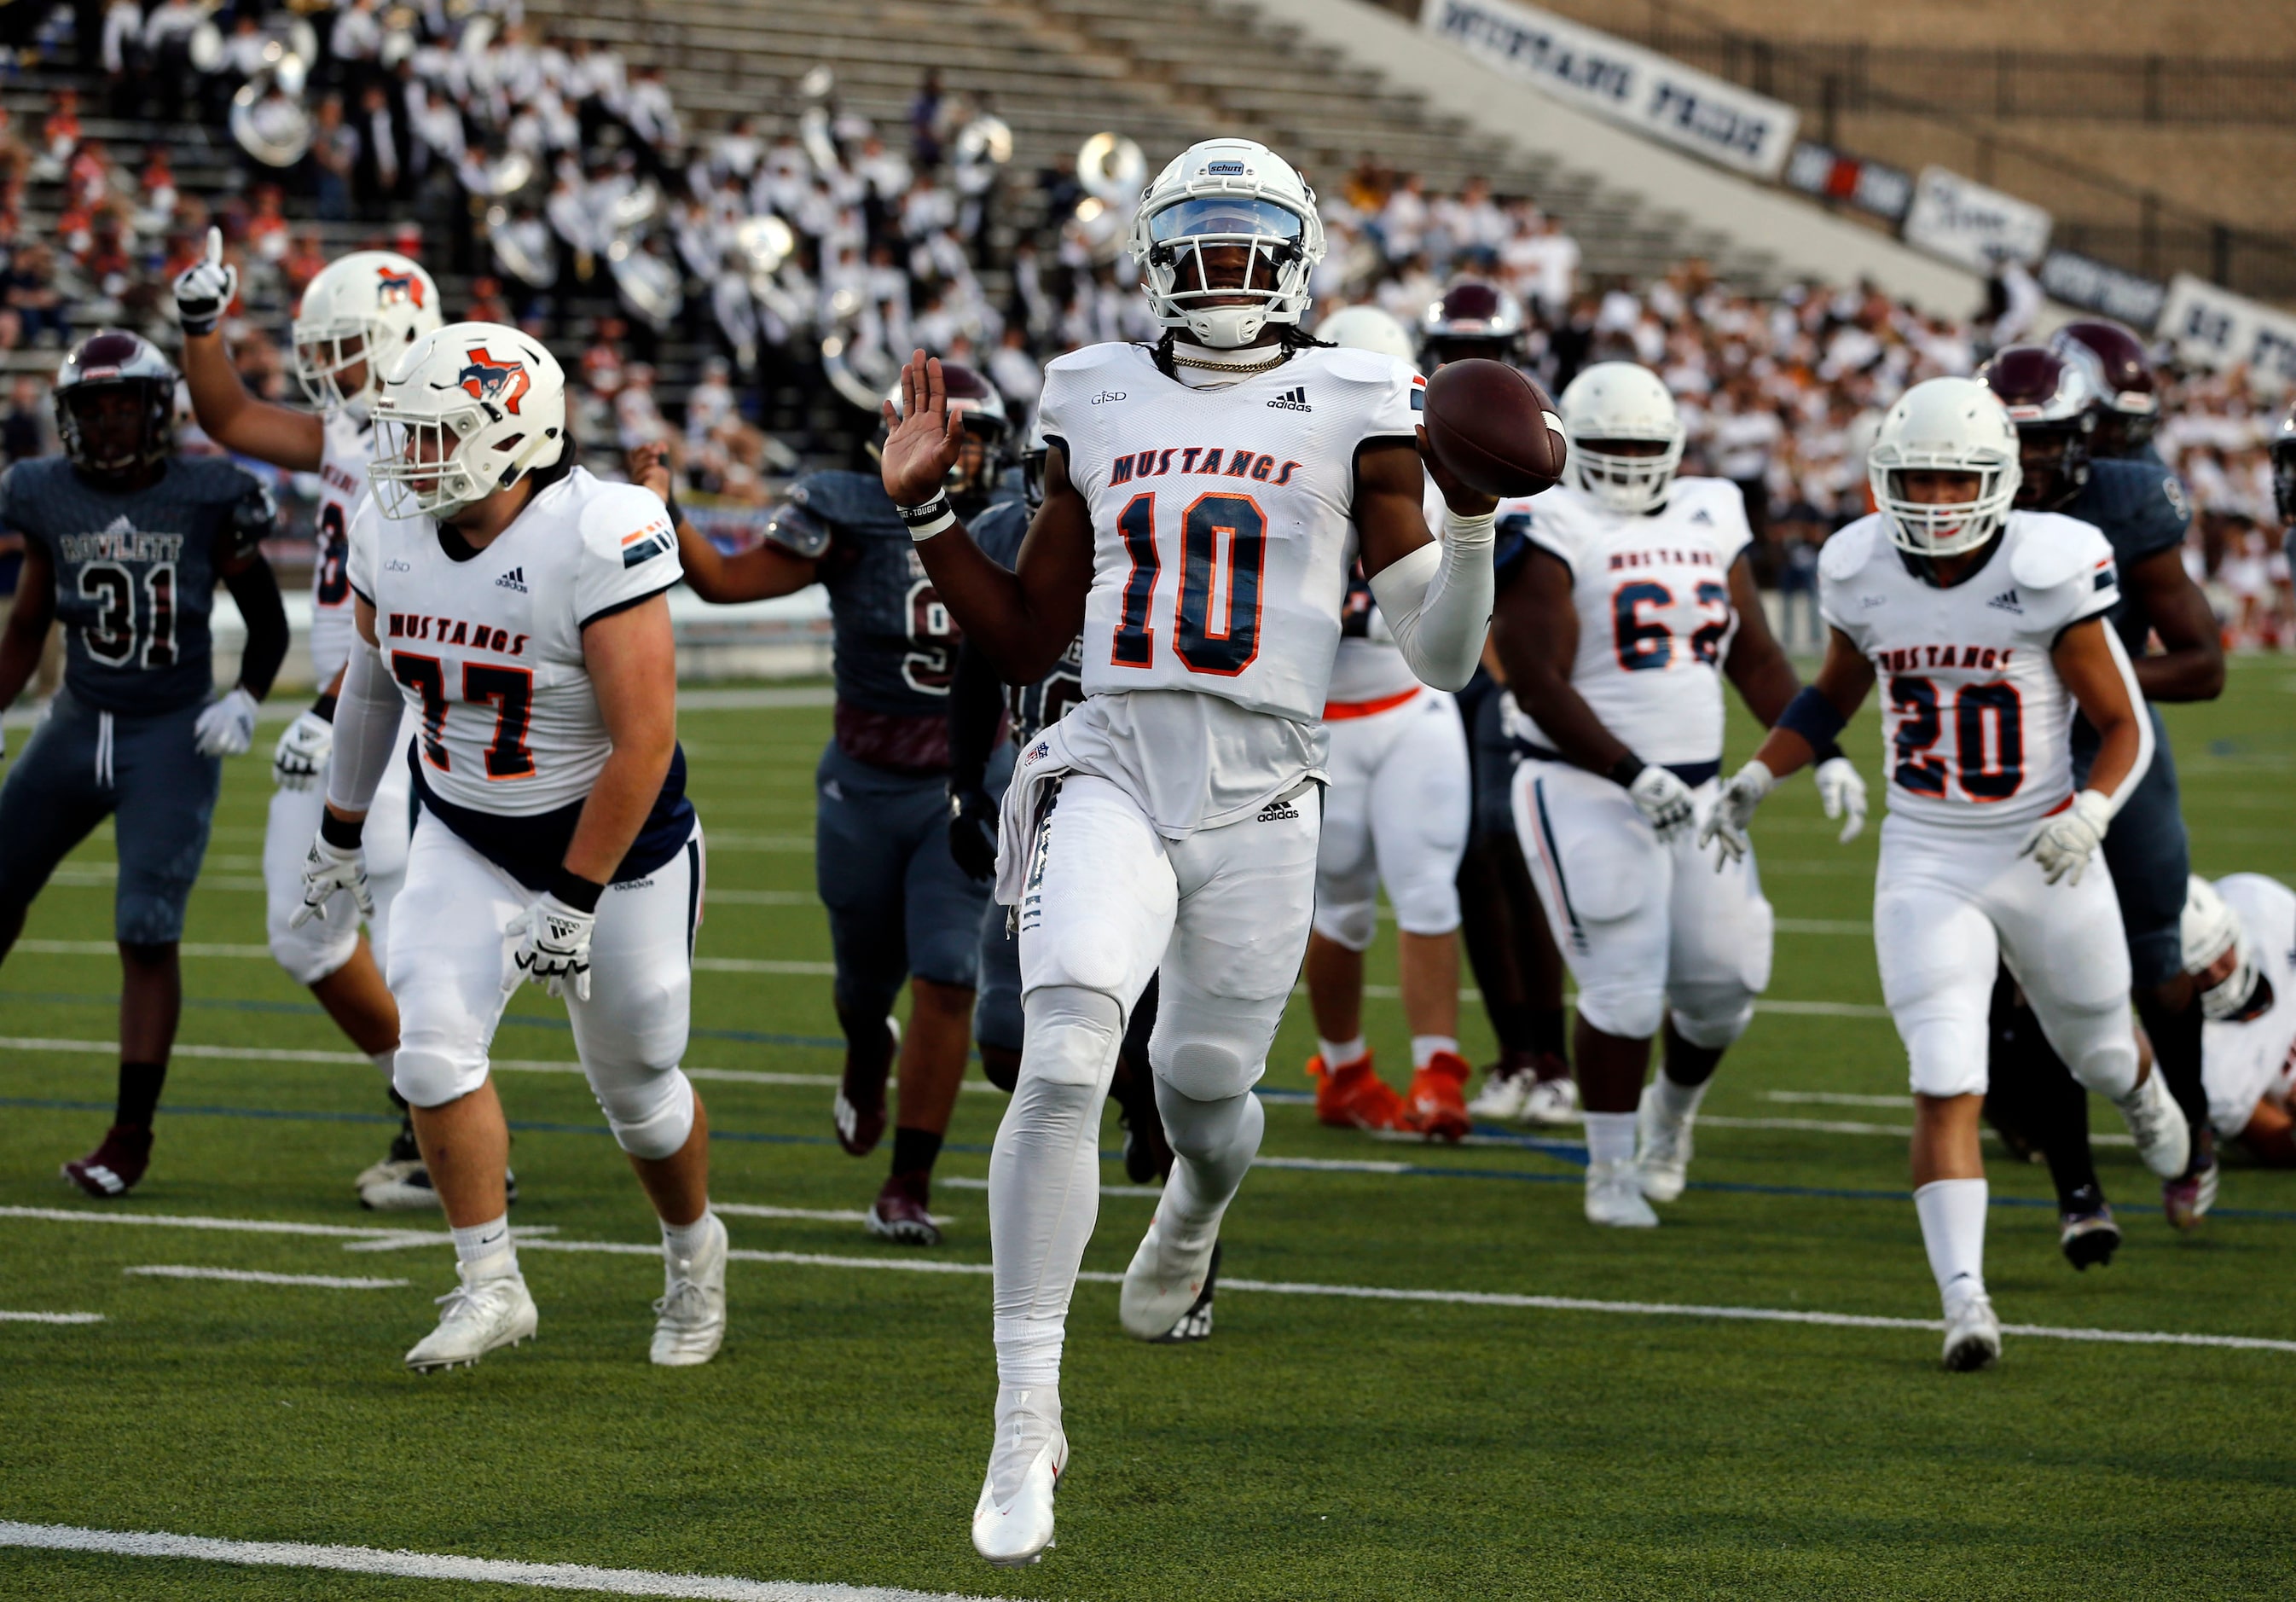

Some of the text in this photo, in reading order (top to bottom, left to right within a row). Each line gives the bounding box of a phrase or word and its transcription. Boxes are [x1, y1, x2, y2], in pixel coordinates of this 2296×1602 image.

[1267, 399, 1312, 413] adidas
[1109, 448, 1302, 487] MUSTANGS
[913, 504, 936, 517] TOUGH
[1609, 549, 1721, 571] MUSTANG
[496, 578, 528, 594] adidas
[1110, 491, 1268, 677] 10
[78, 560, 179, 670] 31
[388, 612, 531, 656] MUSTANGS
[391, 649, 536, 781] 77
[1889, 676, 2025, 803] 20
[1258, 808, 1299, 821] adidas
